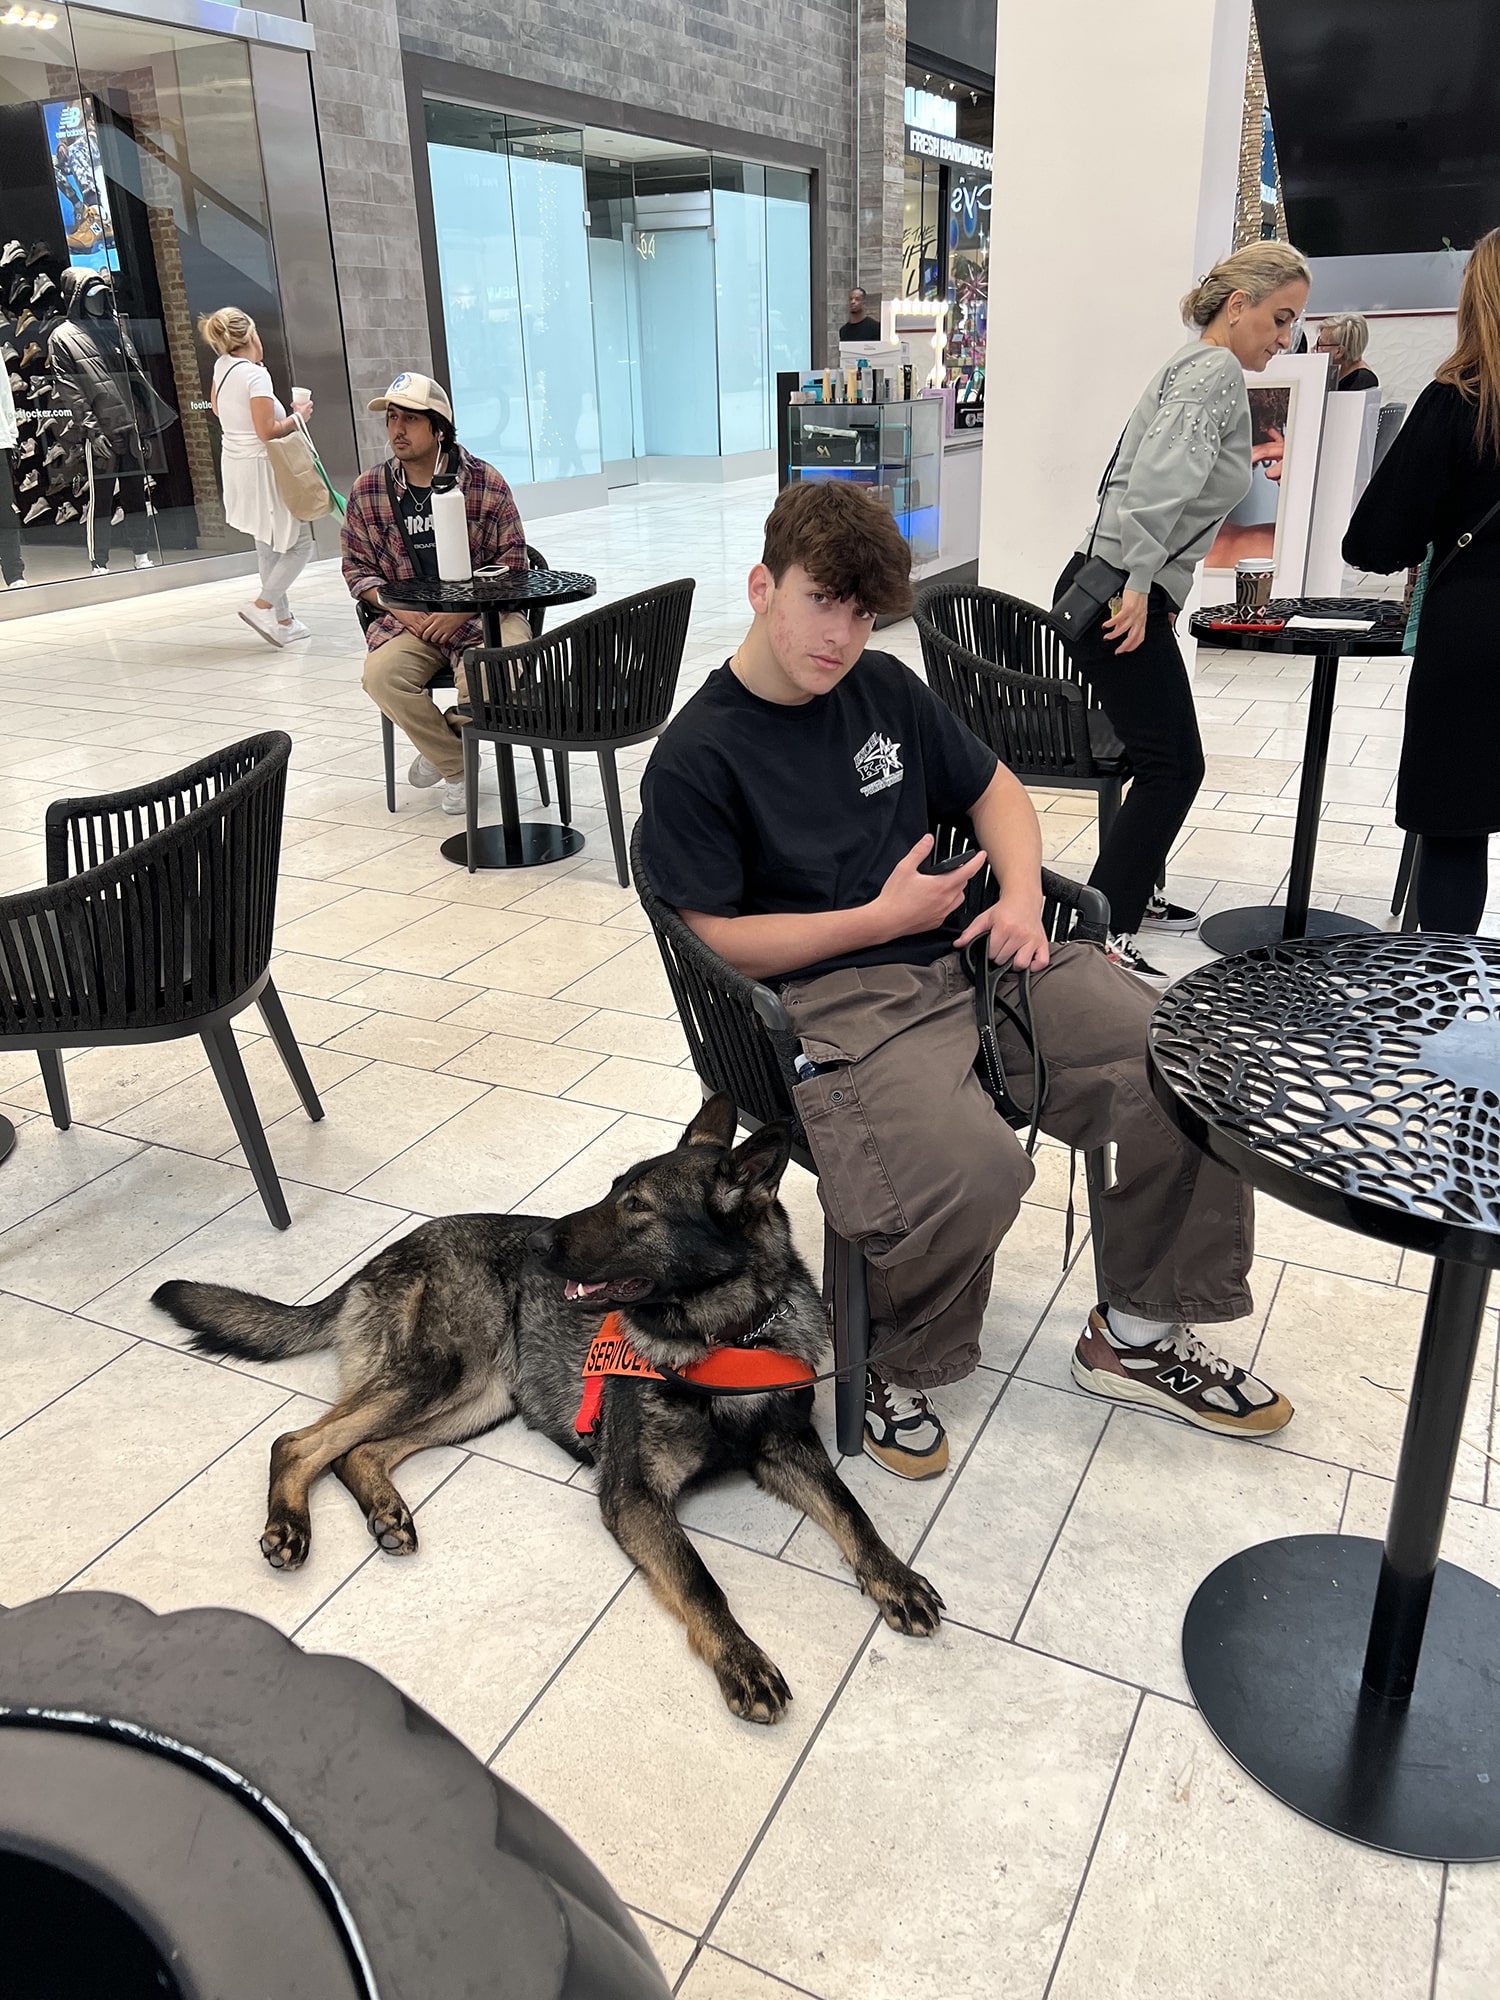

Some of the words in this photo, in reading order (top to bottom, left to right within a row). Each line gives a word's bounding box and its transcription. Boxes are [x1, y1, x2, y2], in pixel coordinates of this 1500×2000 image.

[910, 130, 939, 158] FRESH
[940, 138, 984, 169] HANDMADE
[588, 1339, 641, 1372] SERVICE
